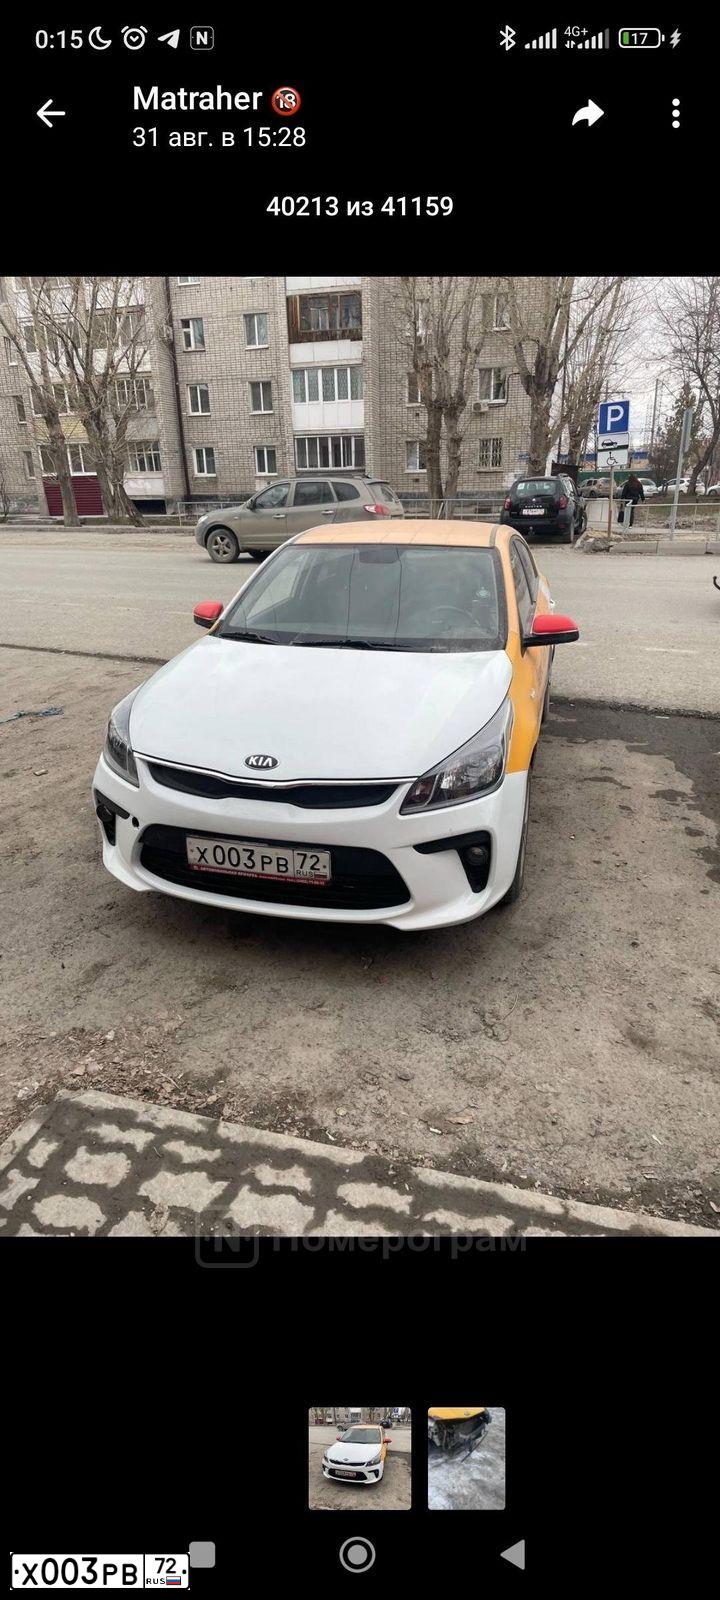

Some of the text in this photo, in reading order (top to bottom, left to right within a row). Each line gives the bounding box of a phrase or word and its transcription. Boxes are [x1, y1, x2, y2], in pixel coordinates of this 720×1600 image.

[606, 405, 624, 431] P
[248, 755, 273, 767] KIA
[296, 852, 320, 872] 72
[296, 870, 314, 878] RUS
